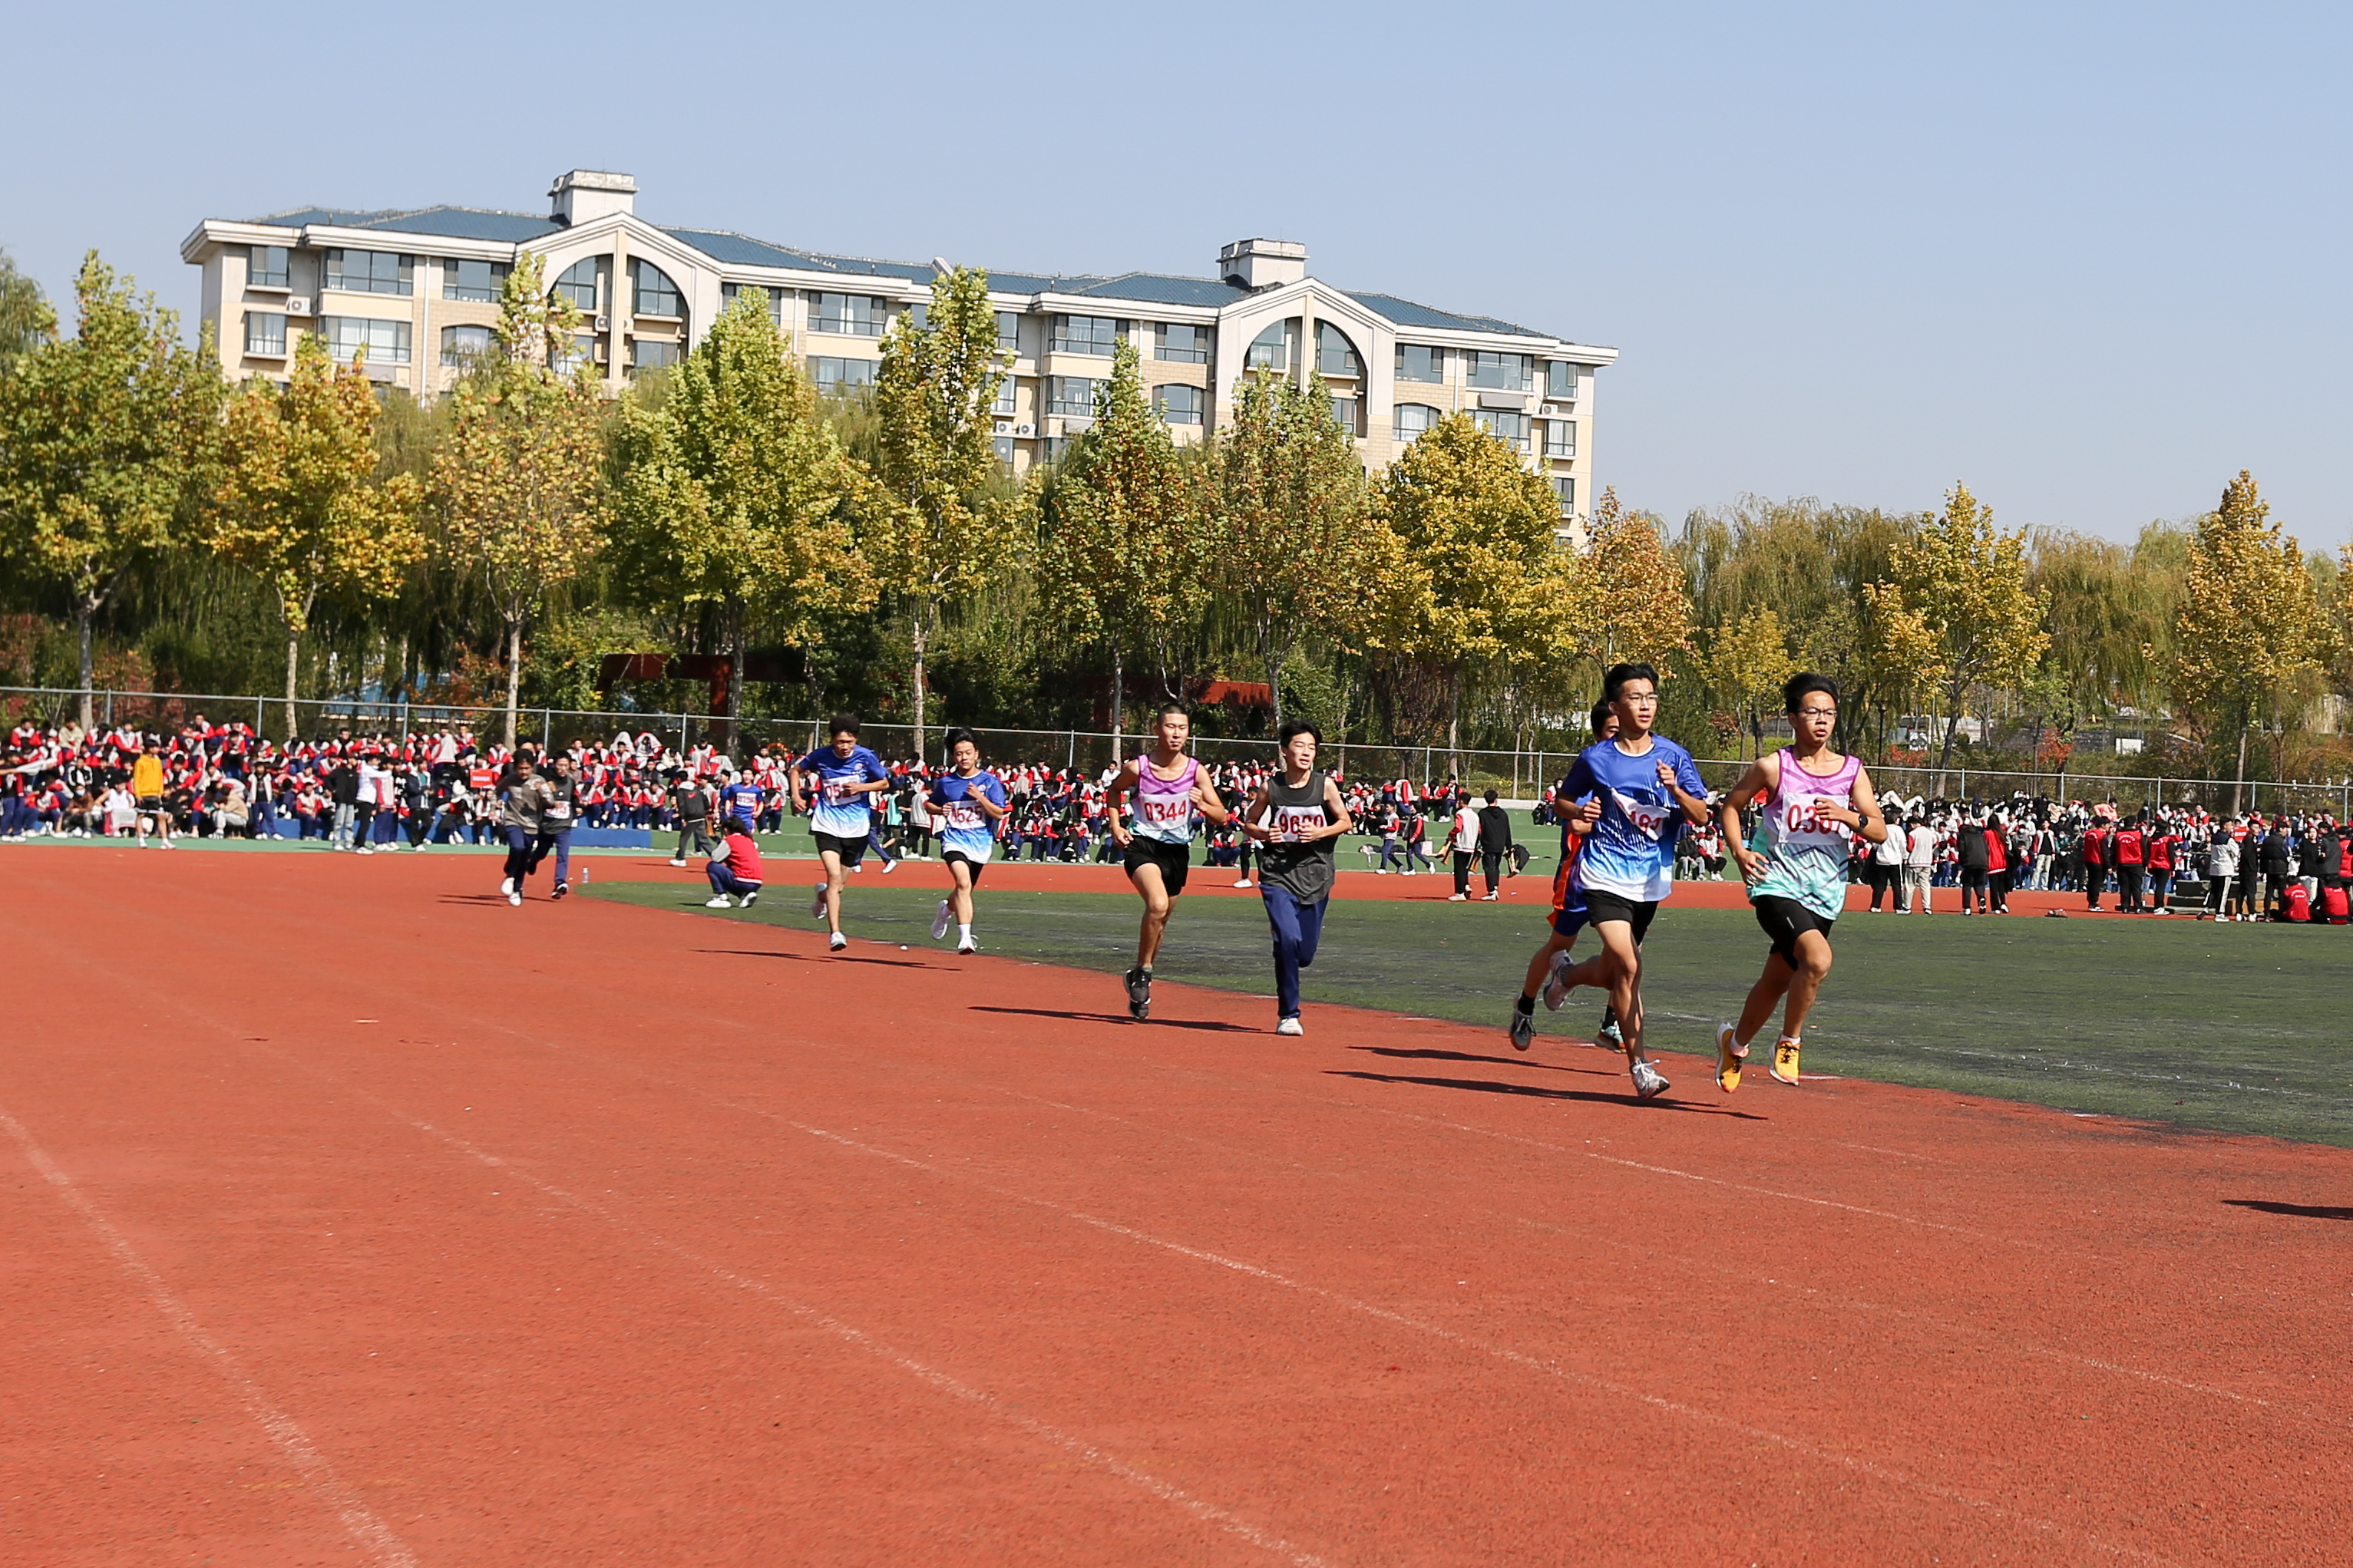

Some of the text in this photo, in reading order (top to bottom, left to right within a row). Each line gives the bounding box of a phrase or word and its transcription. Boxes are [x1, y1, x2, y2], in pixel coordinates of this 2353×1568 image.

[825, 784, 851, 800] 05
[951, 806, 983, 823] 0525
[1145, 800, 1187, 822] 0344
